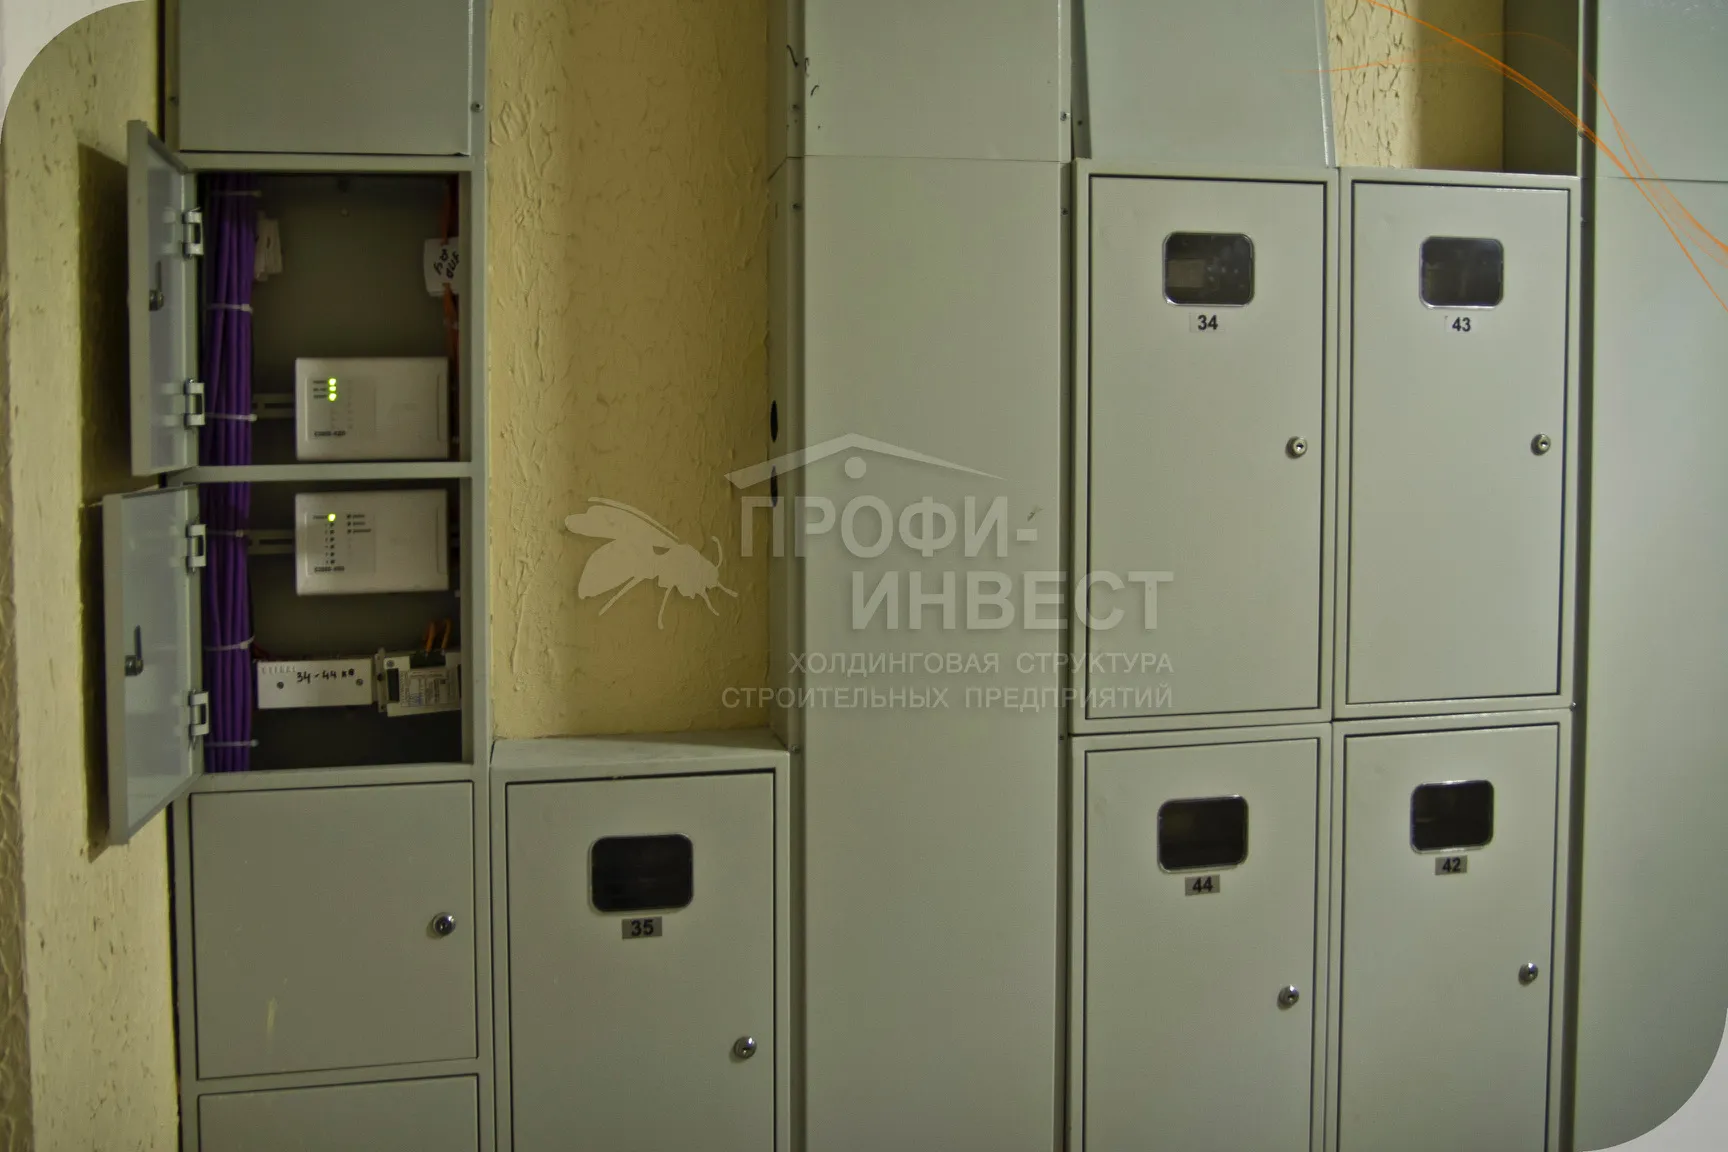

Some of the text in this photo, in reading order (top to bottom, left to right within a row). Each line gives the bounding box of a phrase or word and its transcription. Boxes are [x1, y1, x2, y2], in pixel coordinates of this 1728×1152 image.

[1198, 314, 1219, 331] 34
[1452, 316, 1471, 332] 43
[1442, 856, 1461, 872] 42
[1192, 876, 1213, 893] 44
[631, 919, 654, 937] 35
